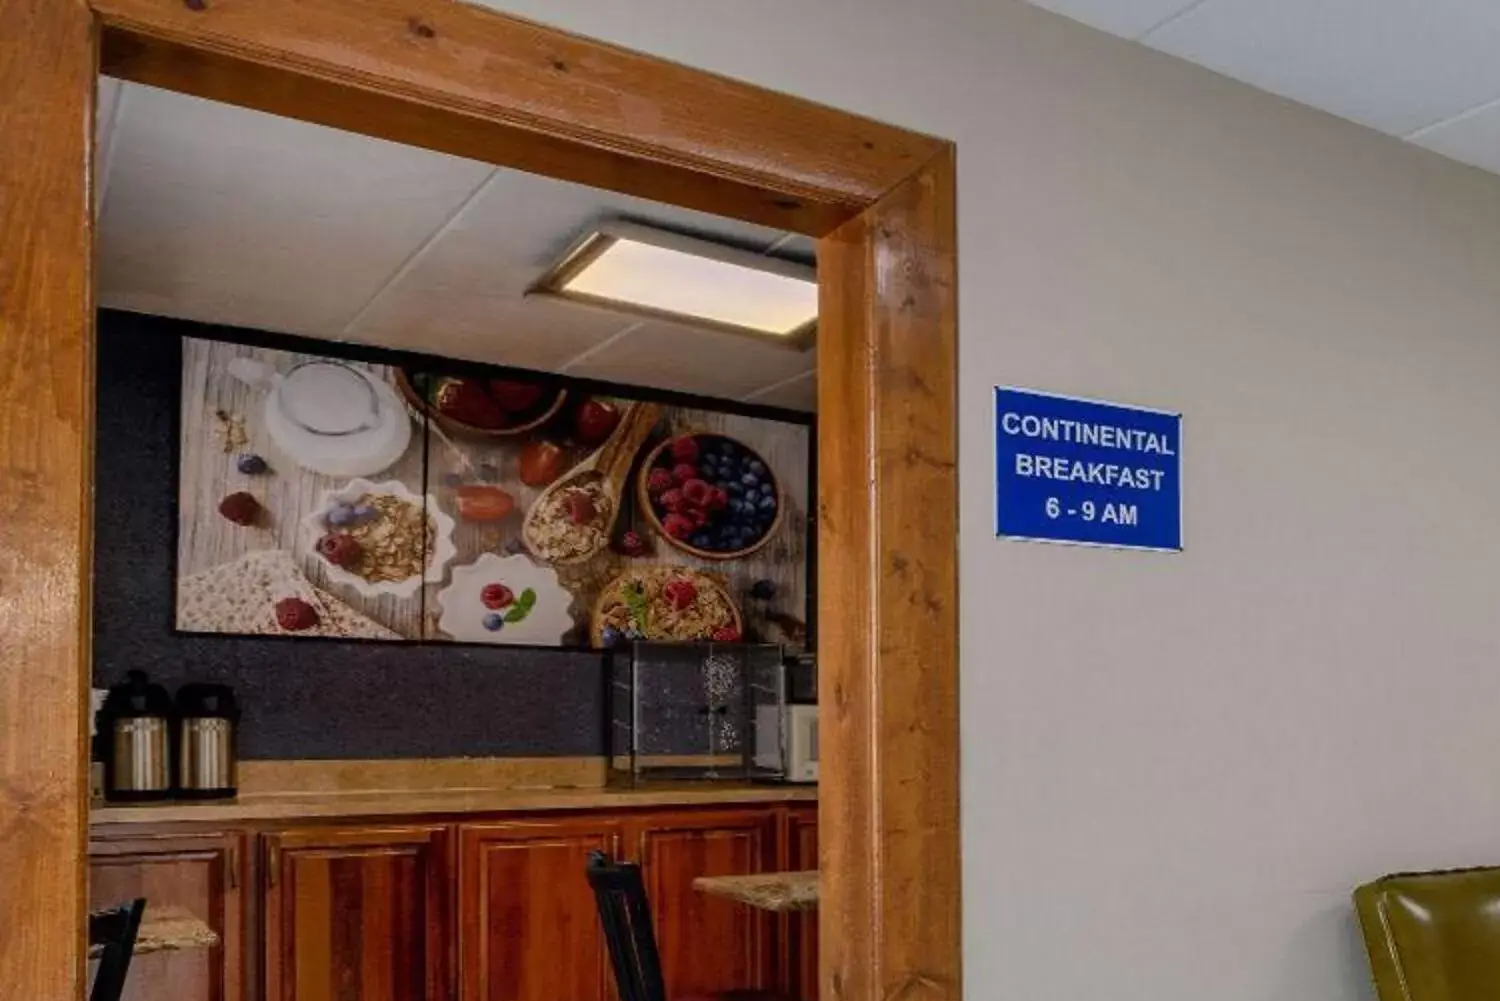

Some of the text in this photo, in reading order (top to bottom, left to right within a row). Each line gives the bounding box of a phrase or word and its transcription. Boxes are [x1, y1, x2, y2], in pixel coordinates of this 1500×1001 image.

[1002, 413, 1175, 456] CONTINENTAL
[1015, 454, 1165, 491] BREAKFAST
[1045, 497, 1060, 519] 6
[1082, 501, 1096, 522] 9
[1101, 503, 1138, 526] AM
